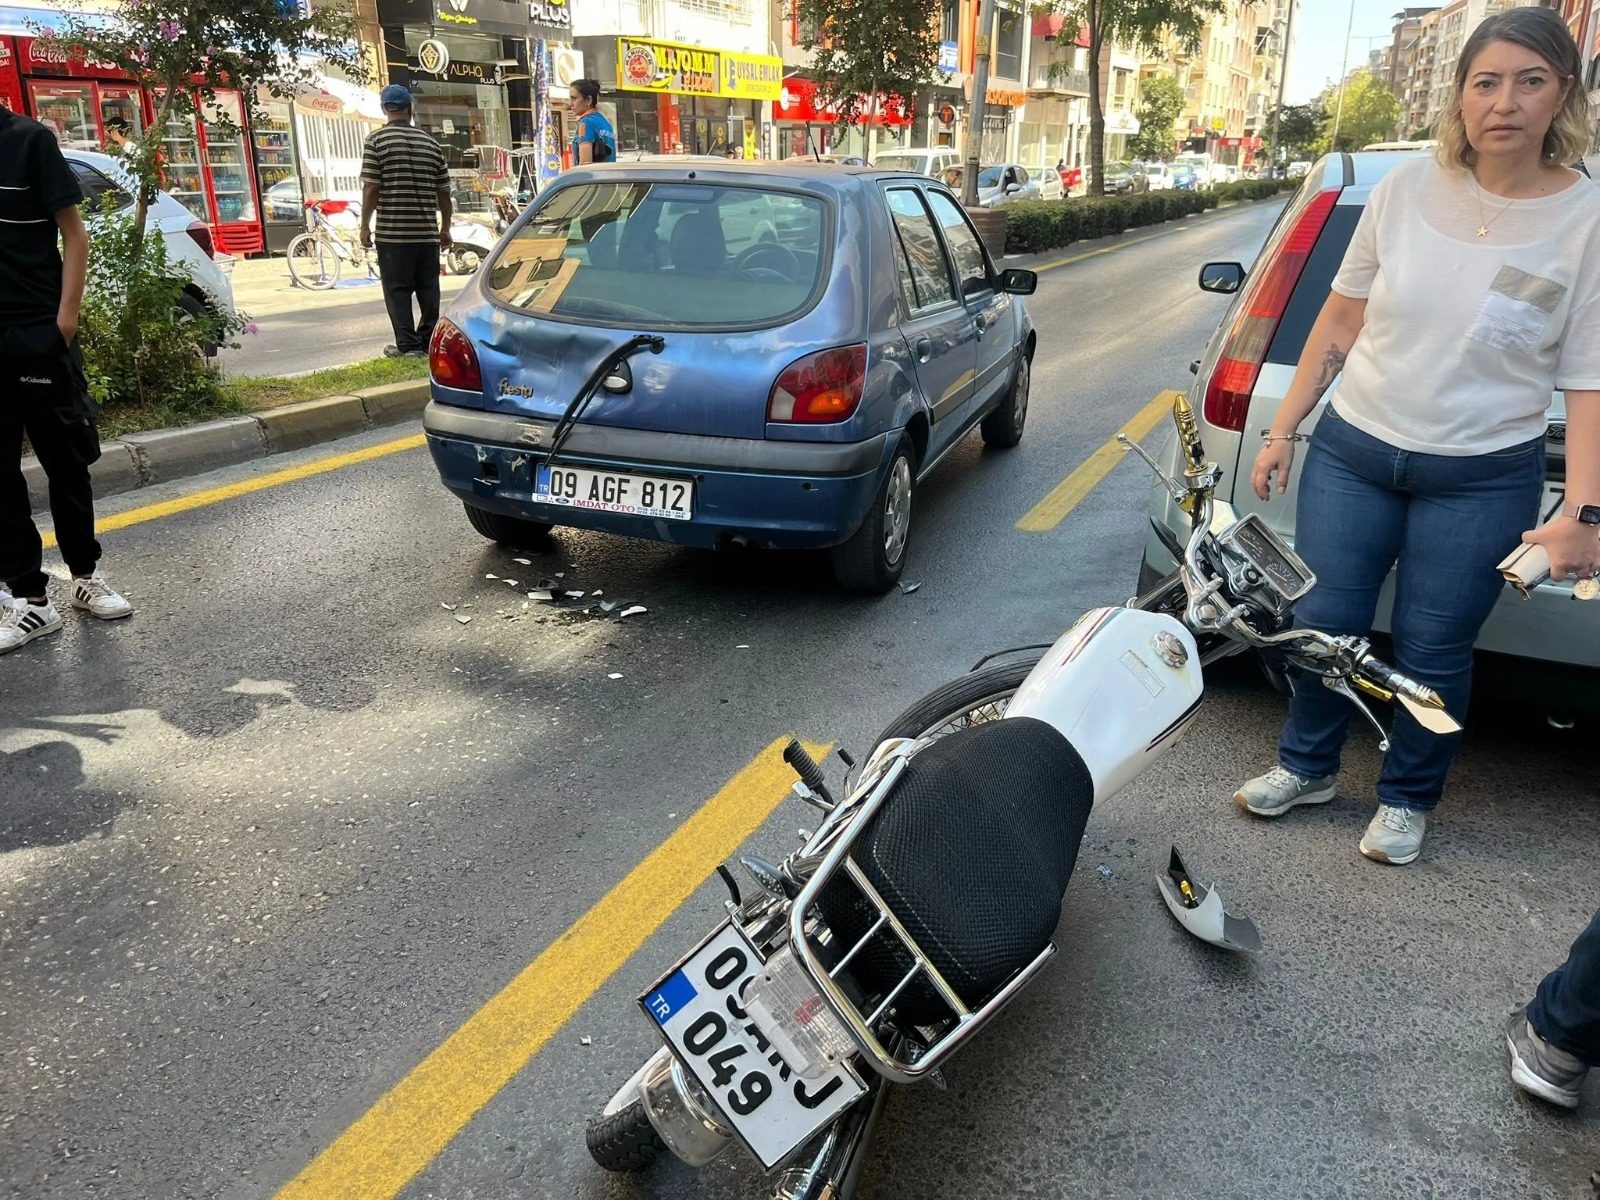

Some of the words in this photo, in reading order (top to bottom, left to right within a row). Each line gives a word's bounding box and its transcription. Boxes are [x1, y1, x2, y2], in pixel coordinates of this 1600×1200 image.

[530, 3, 570, 24] PLUS
[539, 484, 549, 492] TR
[551, 470, 578, 499] 09
[588, 475, 631, 504] AGF
[641, 481, 686, 512] 812
[611, 504, 636, 513] OTO
[652, 993, 671, 1019] TR
[682, 1010, 773, 1116] 049
